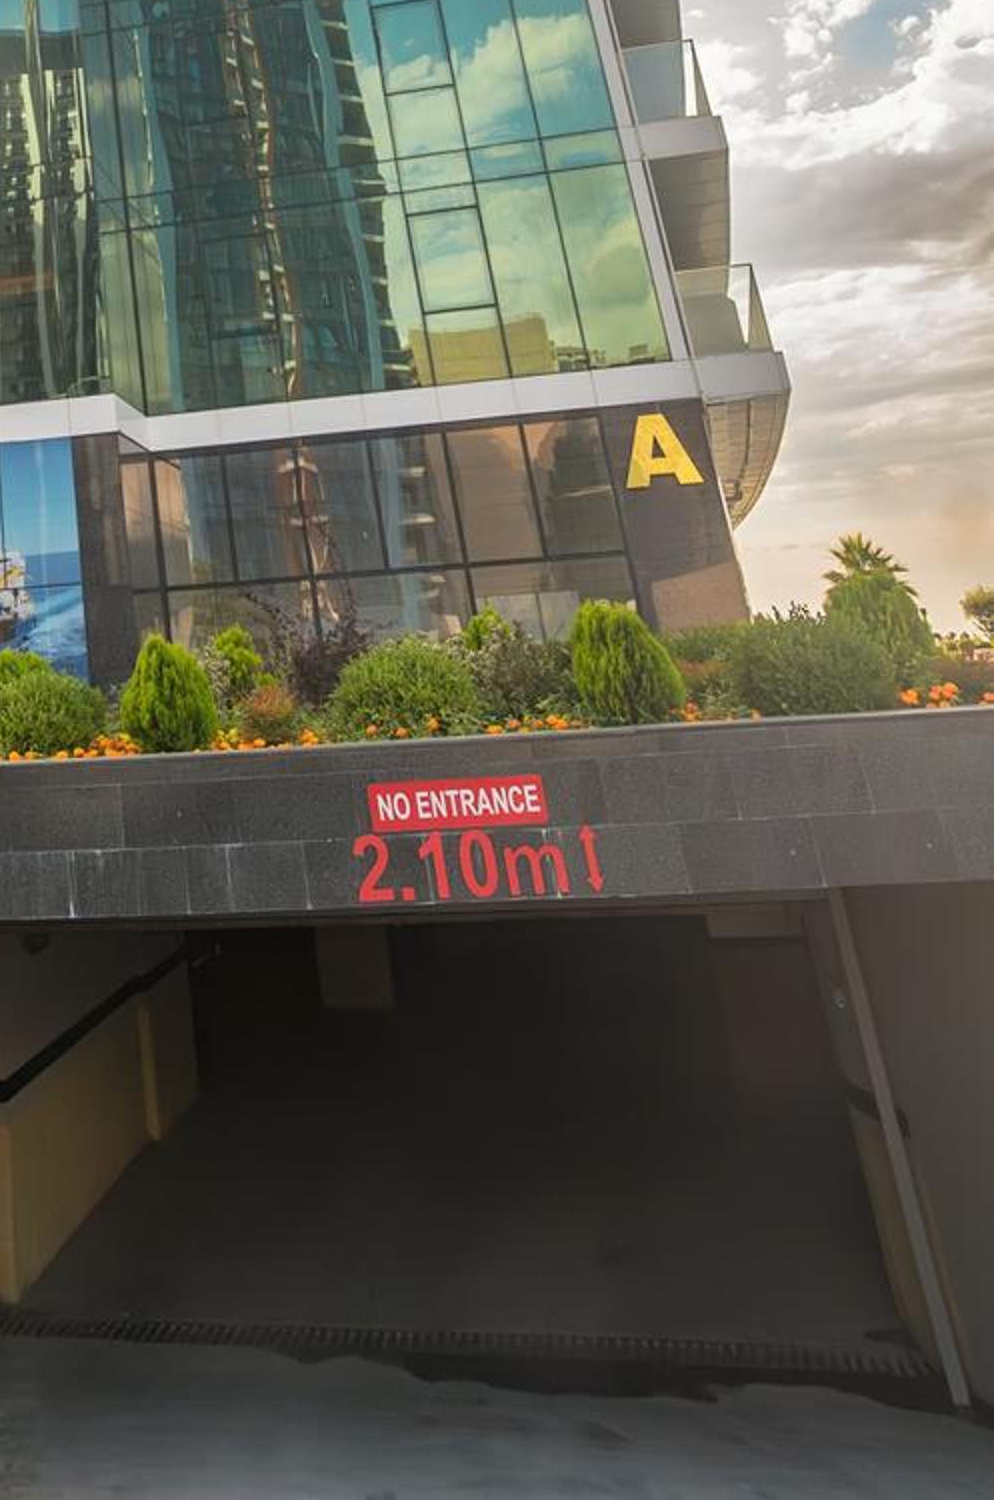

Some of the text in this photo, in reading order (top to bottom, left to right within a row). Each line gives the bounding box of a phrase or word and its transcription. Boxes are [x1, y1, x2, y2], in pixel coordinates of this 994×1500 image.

[626, 413, 705, 489] A
[376, 784, 541, 821] NO ENTRANCE
[353, 829, 570, 903] 2.10m
